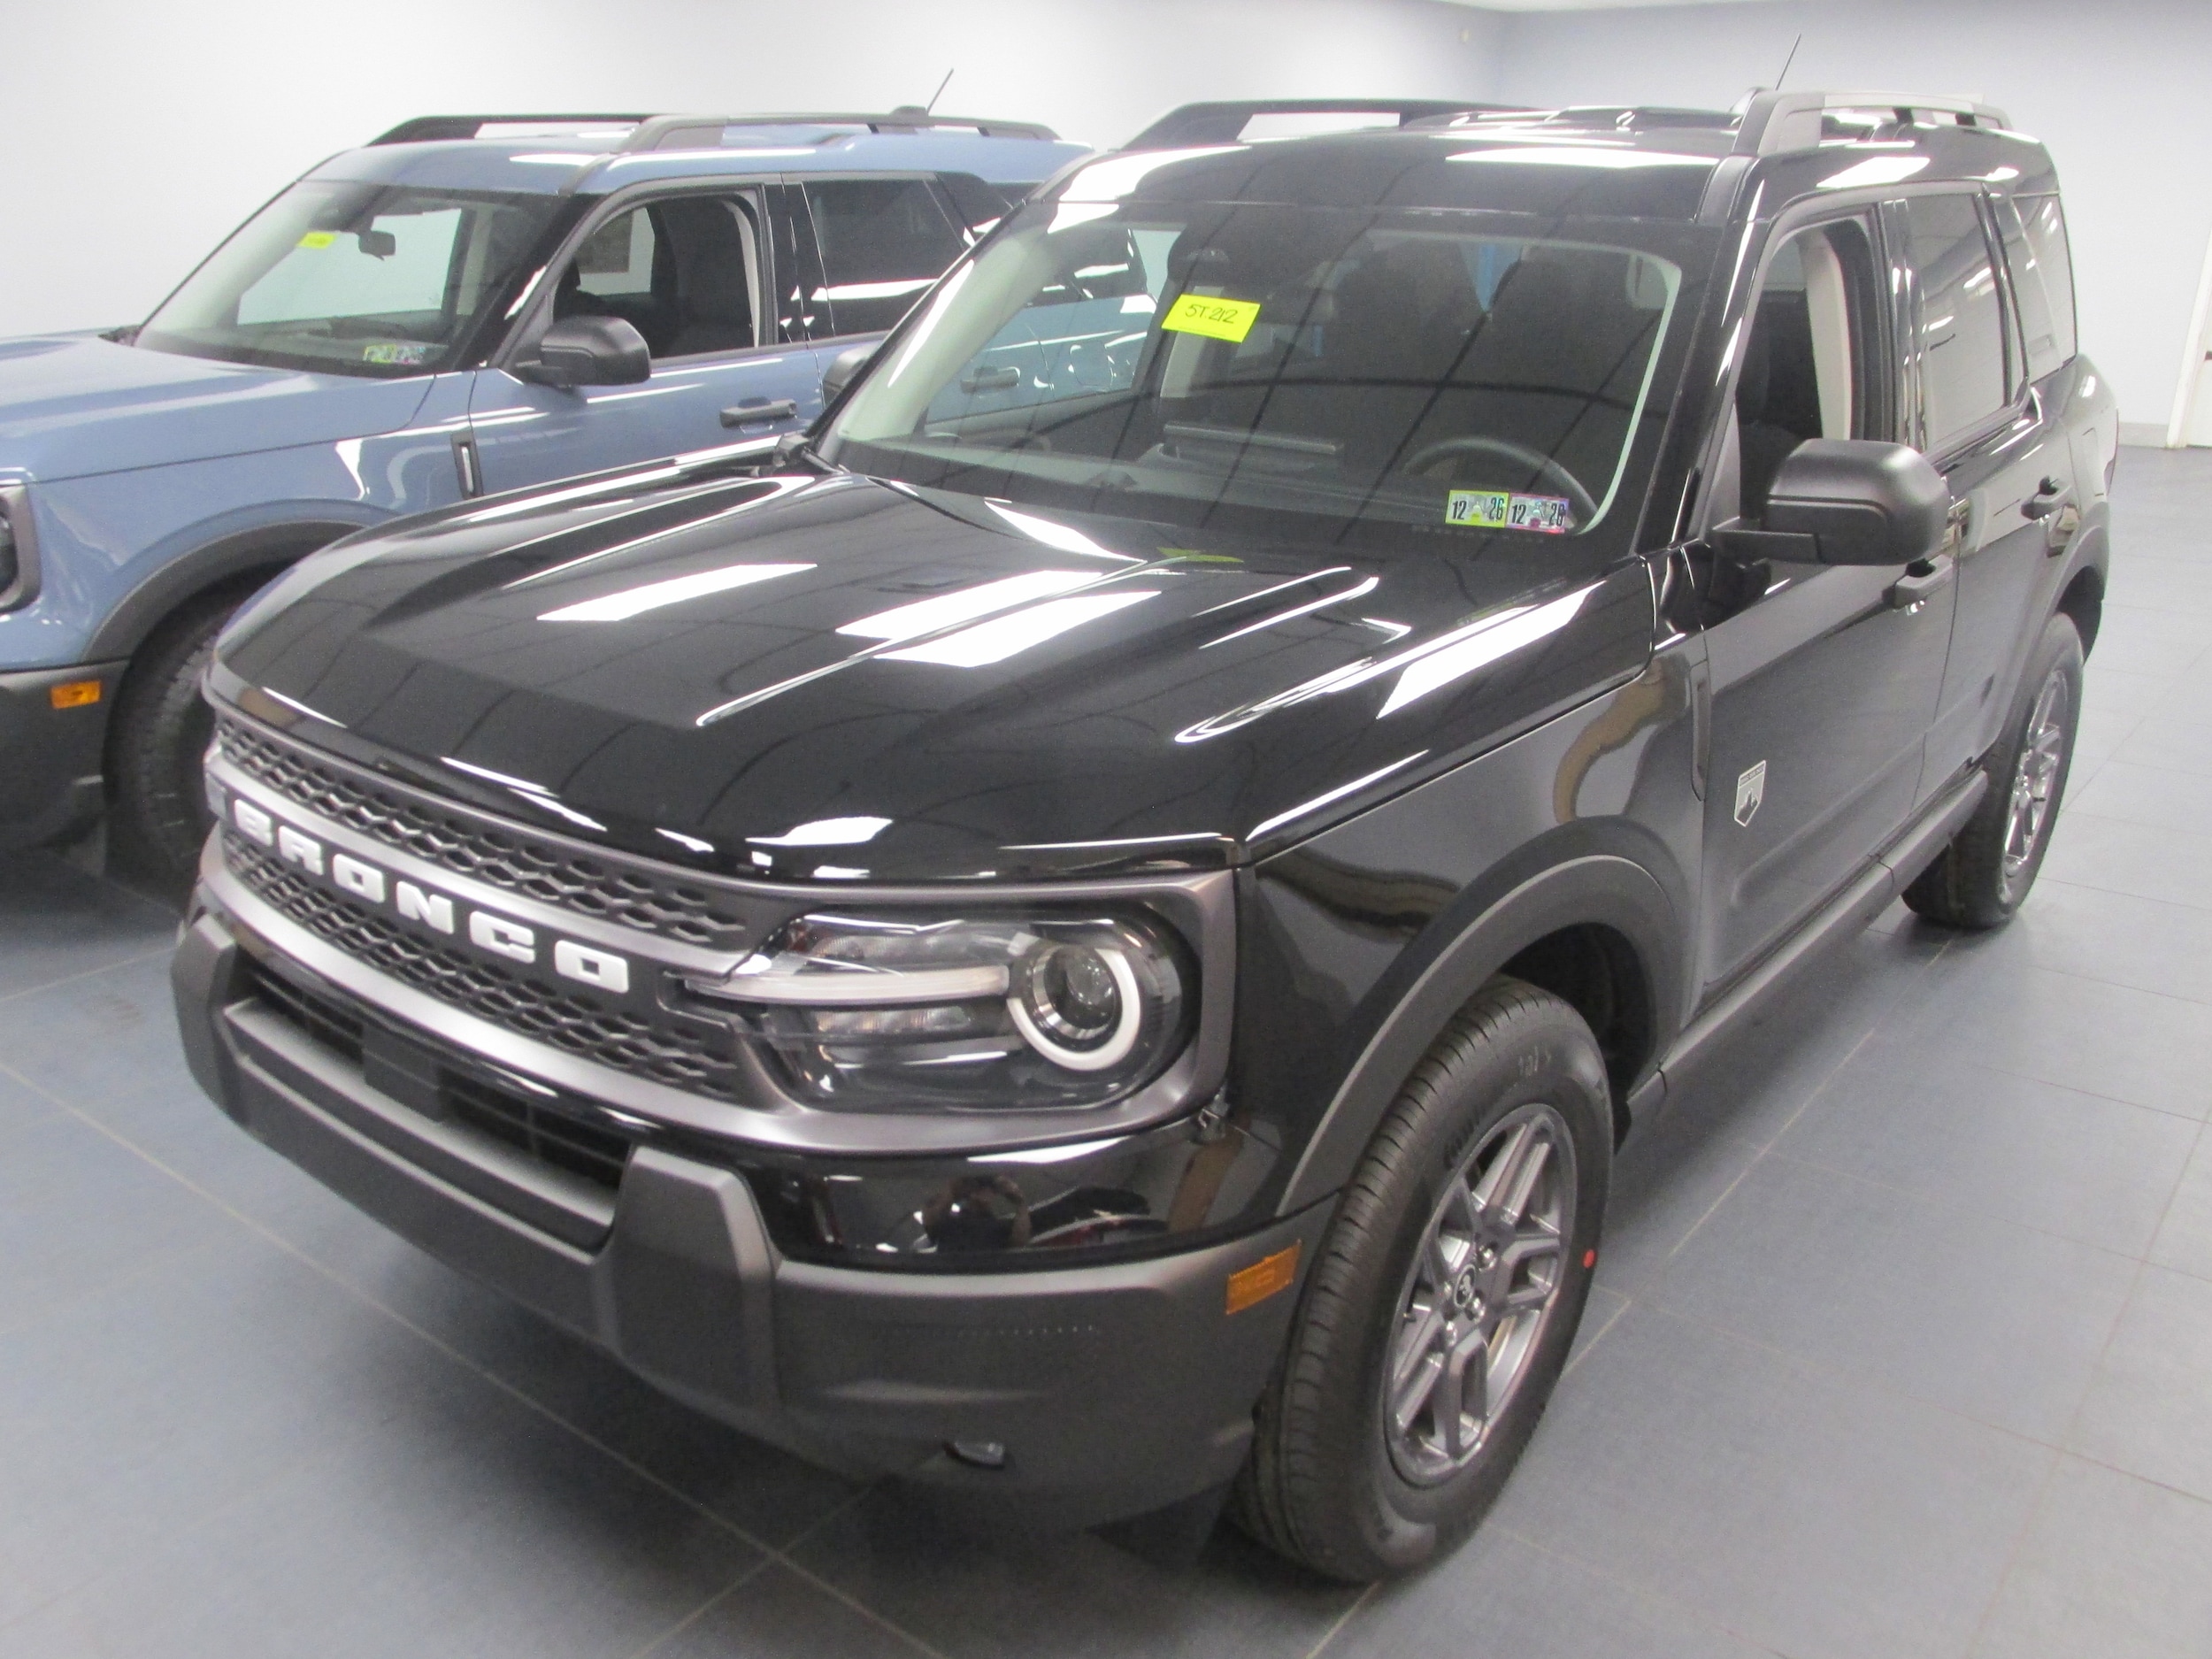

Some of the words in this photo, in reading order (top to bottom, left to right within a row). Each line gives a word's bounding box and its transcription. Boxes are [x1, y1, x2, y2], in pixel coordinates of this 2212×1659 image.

[1452, 500, 1467, 520] 12
[1488, 497, 1504, 520] 26
[1511, 503, 1526, 525] 12
[234, 798, 630, 994] BRONCO
